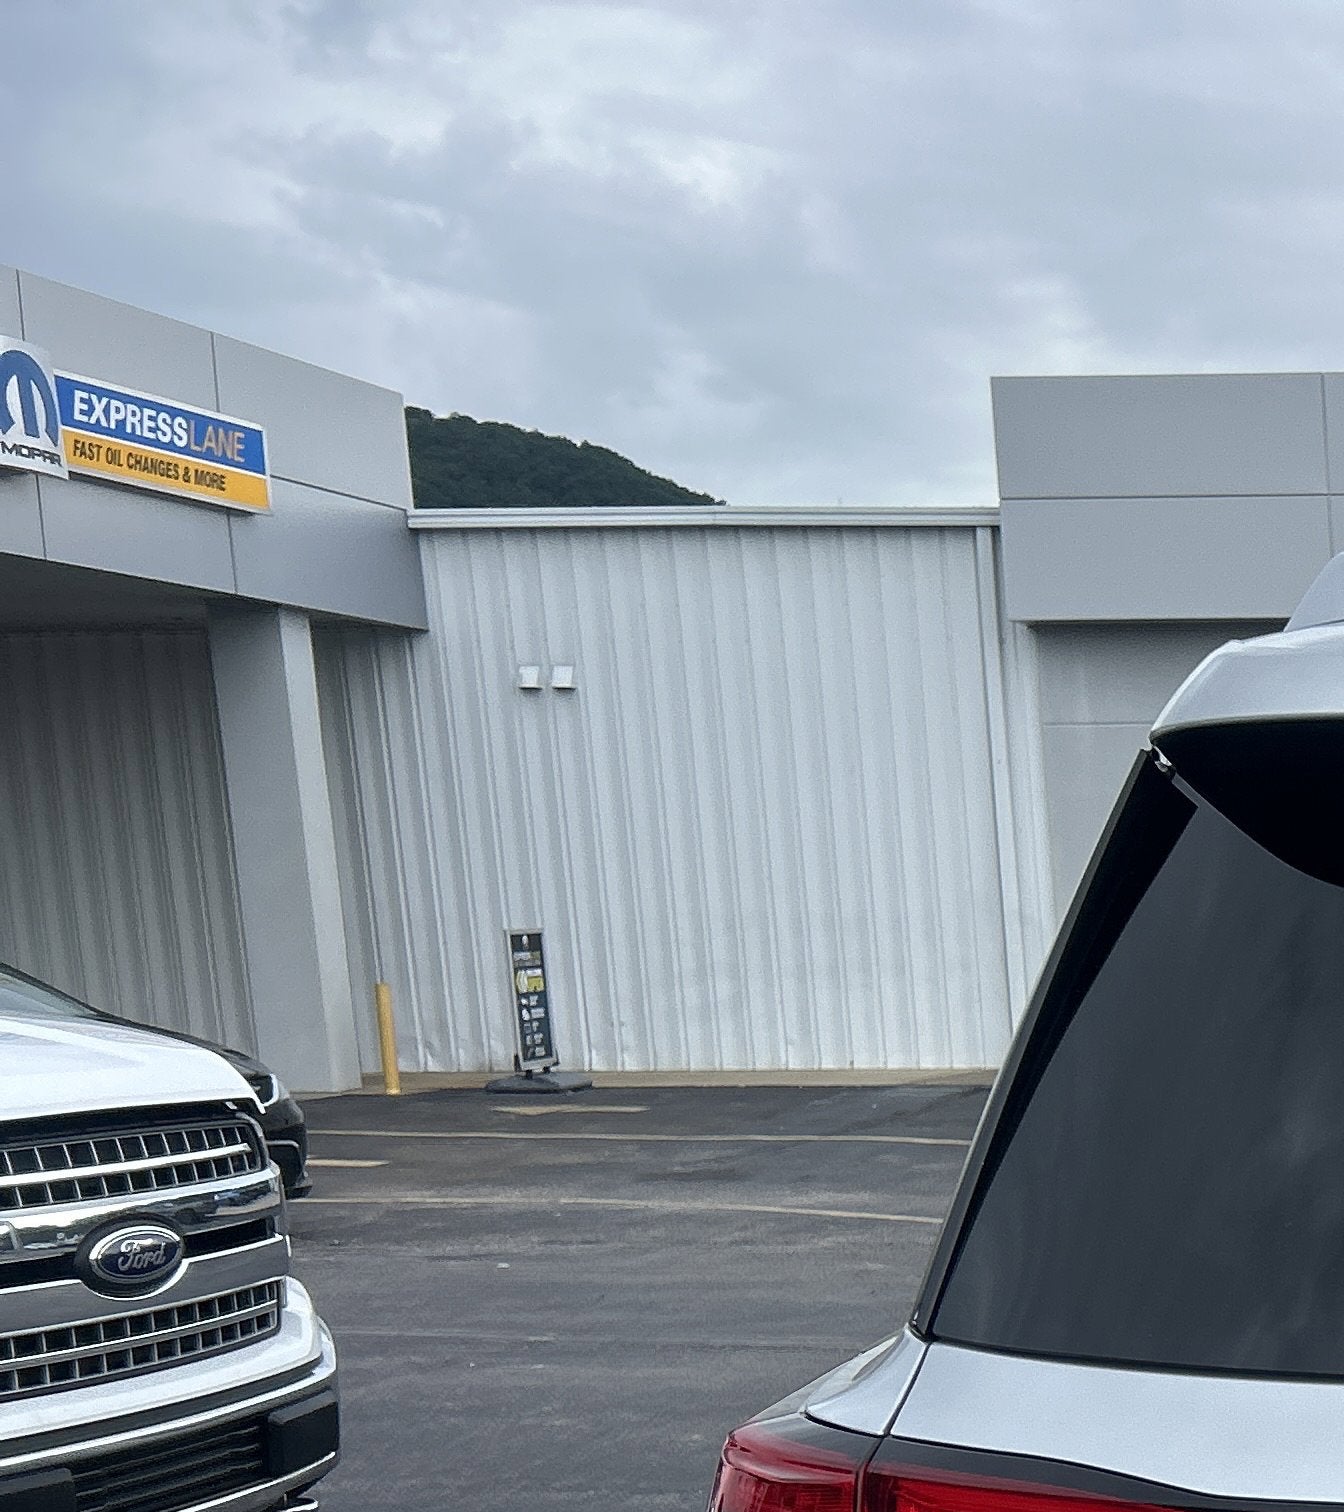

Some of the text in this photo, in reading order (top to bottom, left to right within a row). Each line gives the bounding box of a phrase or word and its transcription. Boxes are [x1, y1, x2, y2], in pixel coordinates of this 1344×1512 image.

[0, 441, 62, 467] MOPAR
[72, 439, 227, 492] FAST OIL CHANGES & MORE
[118, 1238, 167, 1271] Ford
